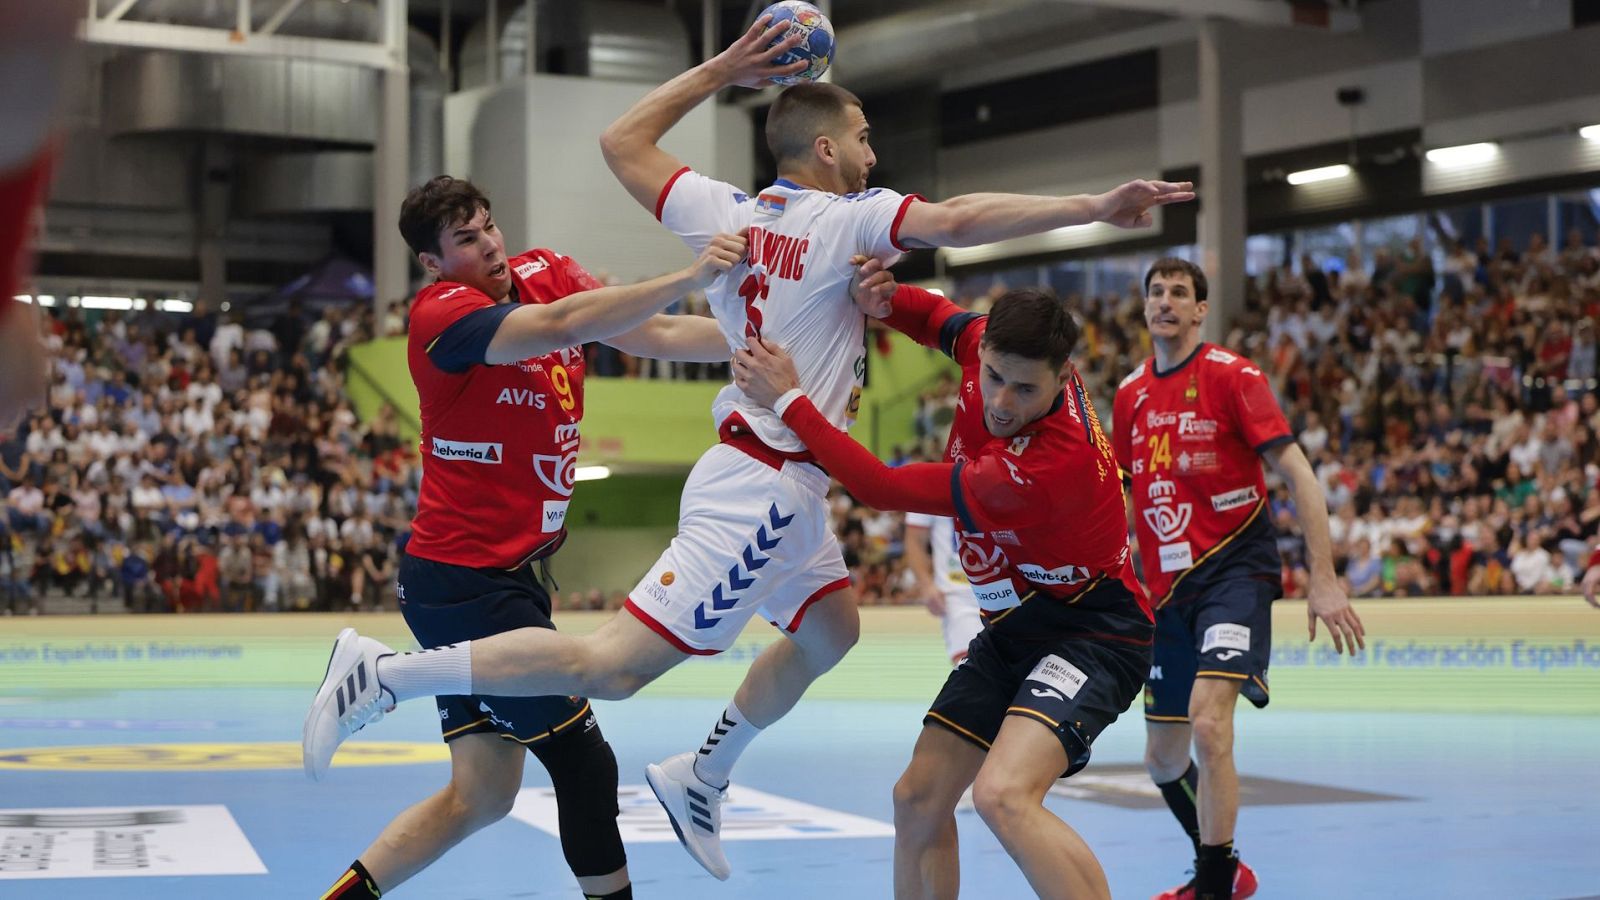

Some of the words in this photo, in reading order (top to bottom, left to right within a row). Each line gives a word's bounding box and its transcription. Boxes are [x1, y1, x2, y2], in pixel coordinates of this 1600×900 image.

[496, 388, 546, 410] AVIS
[551, 364, 575, 411] 9
[434, 442, 483, 459] helvetia
[1148, 432, 1172, 473] 24
[1045, 661, 1081, 686] CANTABRIA
